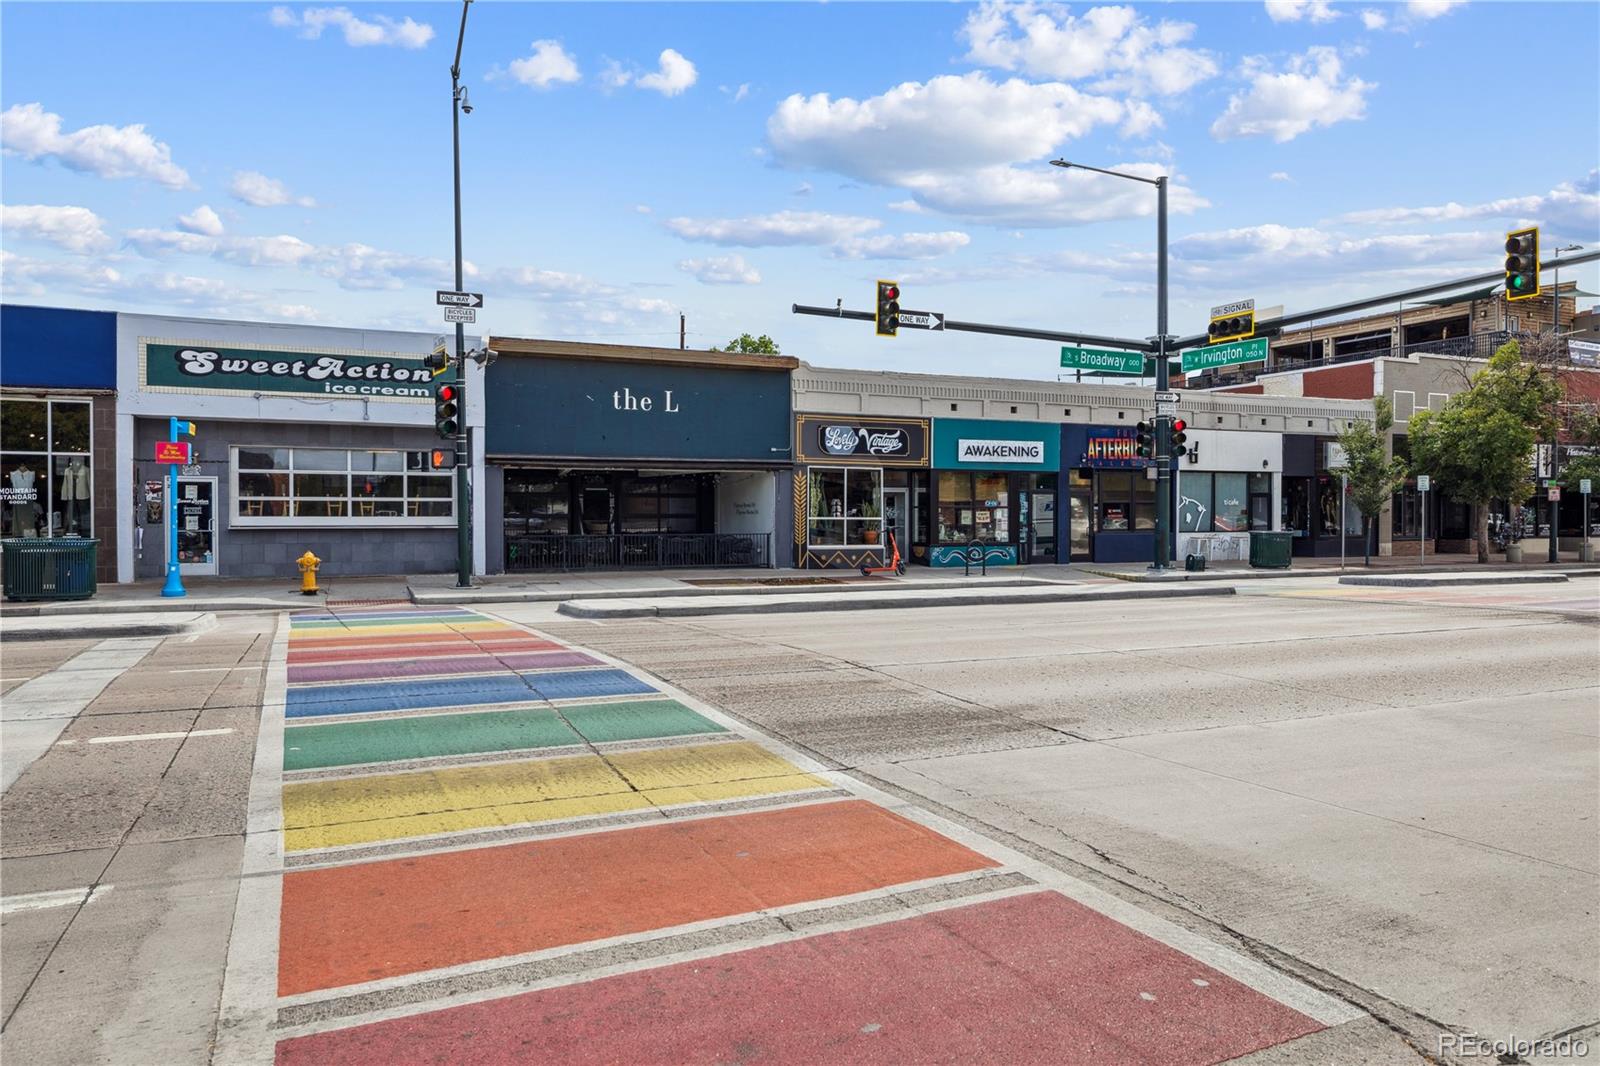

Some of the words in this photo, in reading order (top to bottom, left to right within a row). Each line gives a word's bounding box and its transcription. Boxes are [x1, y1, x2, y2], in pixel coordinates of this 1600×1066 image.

[1223, 301, 1252, 314] SIGNAL
[900, 315, 914, 323] ONE
[1080, 351, 1126, 371] Broadway
[1200, 347, 1243, 364] Irvington
[180, 350, 305, 376] Sweet
[307, 356, 432, 382] Action
[324, 382, 357, 394] ice
[360, 385, 430, 397] cream
[613, 387, 653, 412] the
[664, 390, 679, 413] L
[825, 427, 859, 450] Lovely
[858, 428, 903, 456] Vintage
[964, 445, 1039, 458] AWAKENING
[0, 487, 38, 495] MOUNTAIN
[0, 493, 38, 501] STANDARD
